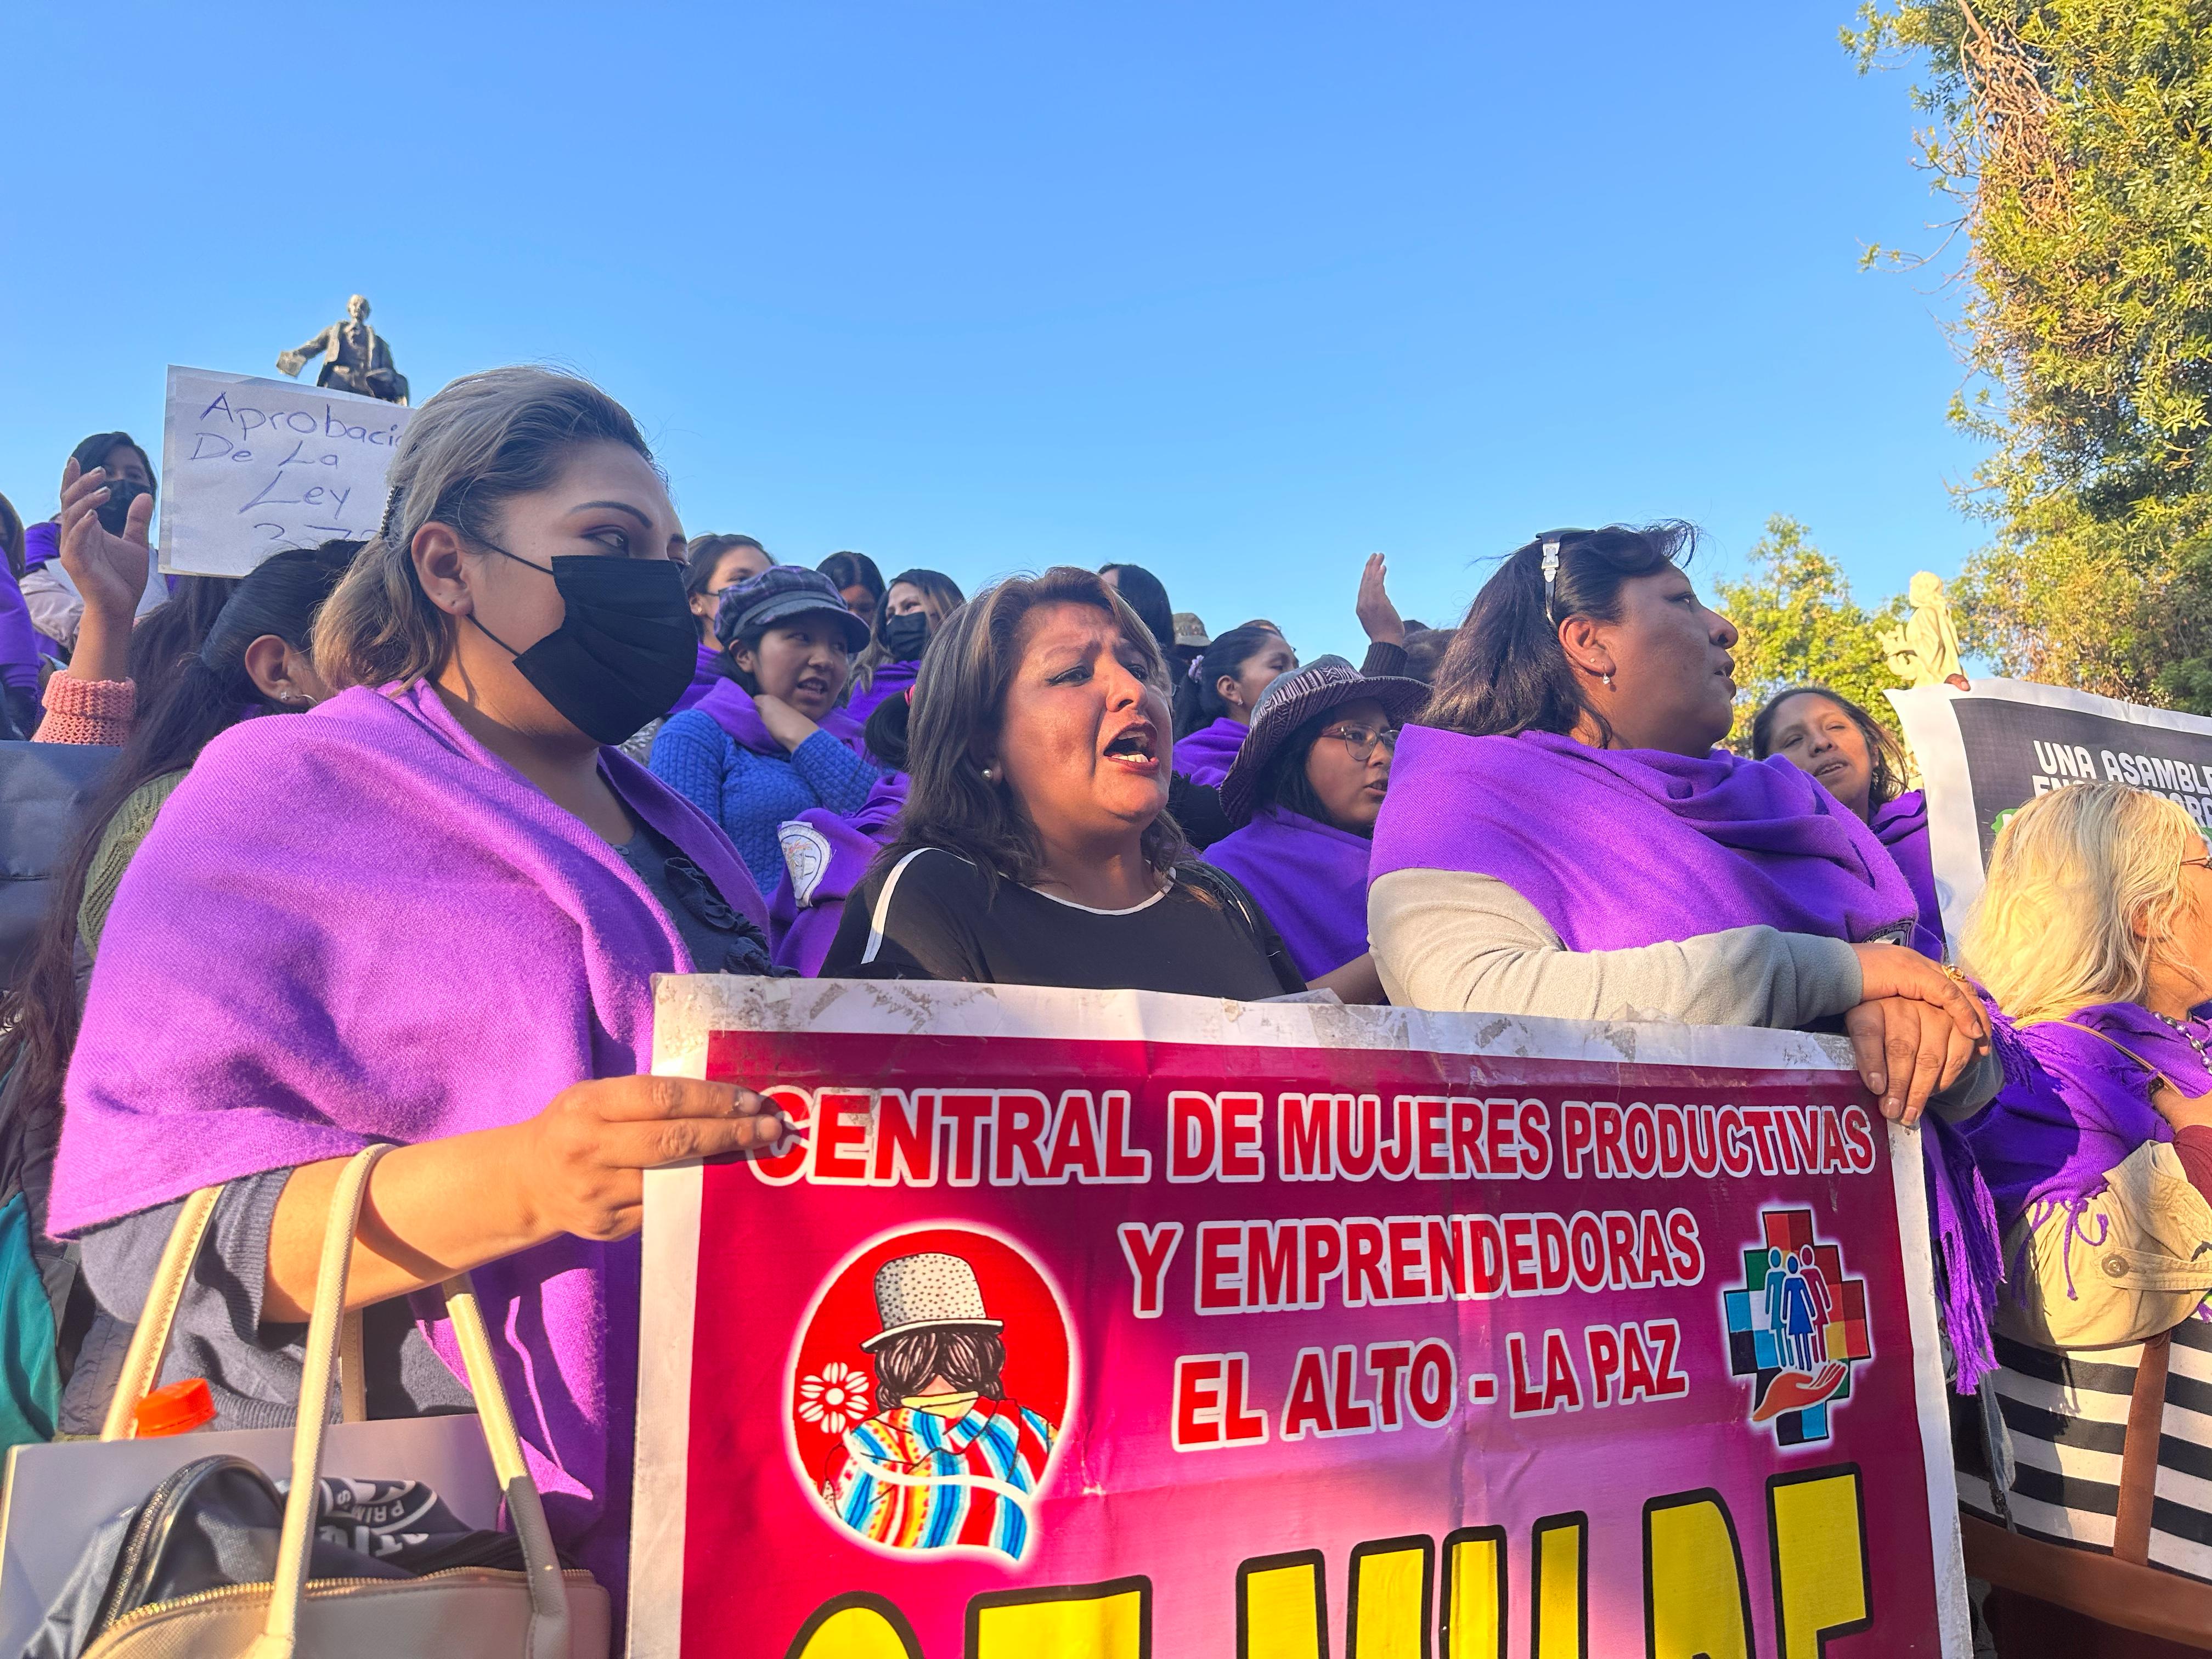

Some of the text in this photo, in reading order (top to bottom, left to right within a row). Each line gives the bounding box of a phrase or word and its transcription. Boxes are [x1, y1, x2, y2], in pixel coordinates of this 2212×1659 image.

[200, 391, 400, 449] Aprobaci
[188, 432, 339, 470] De La
[238, 470, 351, 520] Ley
[2033, 740, 2097, 780] UNA
[747, 1085, 1876, 1187] CENTRAL DE MUJERES PRODUCTIVAS
[1118, 1207, 1706, 1318] Y EMPRENDEDORAS
[1172, 1352, 1268, 1452] EL
[1281, 1338, 1457, 1441] ALTO
[1505, 1328, 1583, 1420] LA
[1584, 1318, 1689, 1408] PAZ
